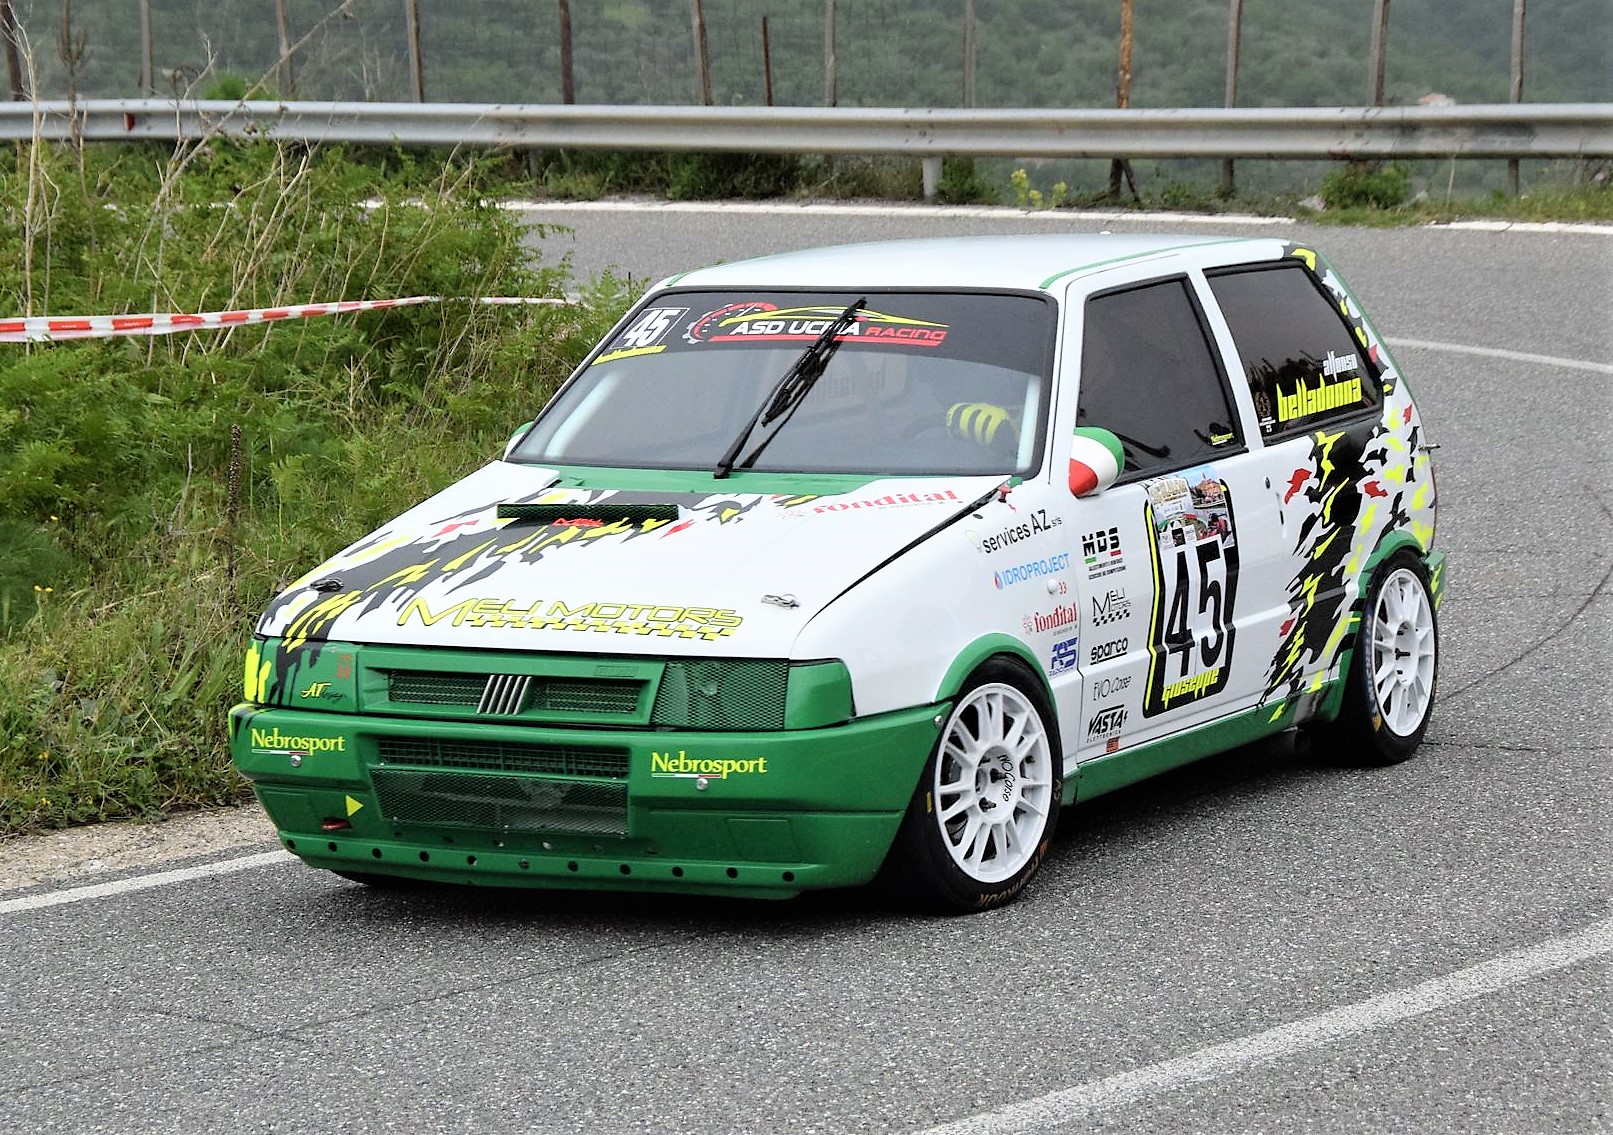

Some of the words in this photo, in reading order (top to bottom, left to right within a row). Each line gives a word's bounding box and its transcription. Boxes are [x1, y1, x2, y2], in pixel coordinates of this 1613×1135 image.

[623, 309, 680, 347] 45
[728, 320, 789, 336] ASD
[865, 326, 947, 341] RACING
[1323, 351, 1358, 382] alfonso
[1276, 373, 1362, 422] belladonna
[982, 522, 1031, 554] services
[1031, 509, 1052, 535] AZ
[1003, 553, 1070, 586] IDROPROJECT
[397, 597, 543, 627] MELI
[546, 600, 743, 627] MOTORS
[1034, 603, 1078, 633] fondital
[1164, 539, 1226, 678] 45
[1091, 637, 1128, 662] sparco
[1161, 667, 1220, 709] giuseppe
[251, 728, 346, 756] Nebrosport
[651, 751, 768, 779] Nebrosport
